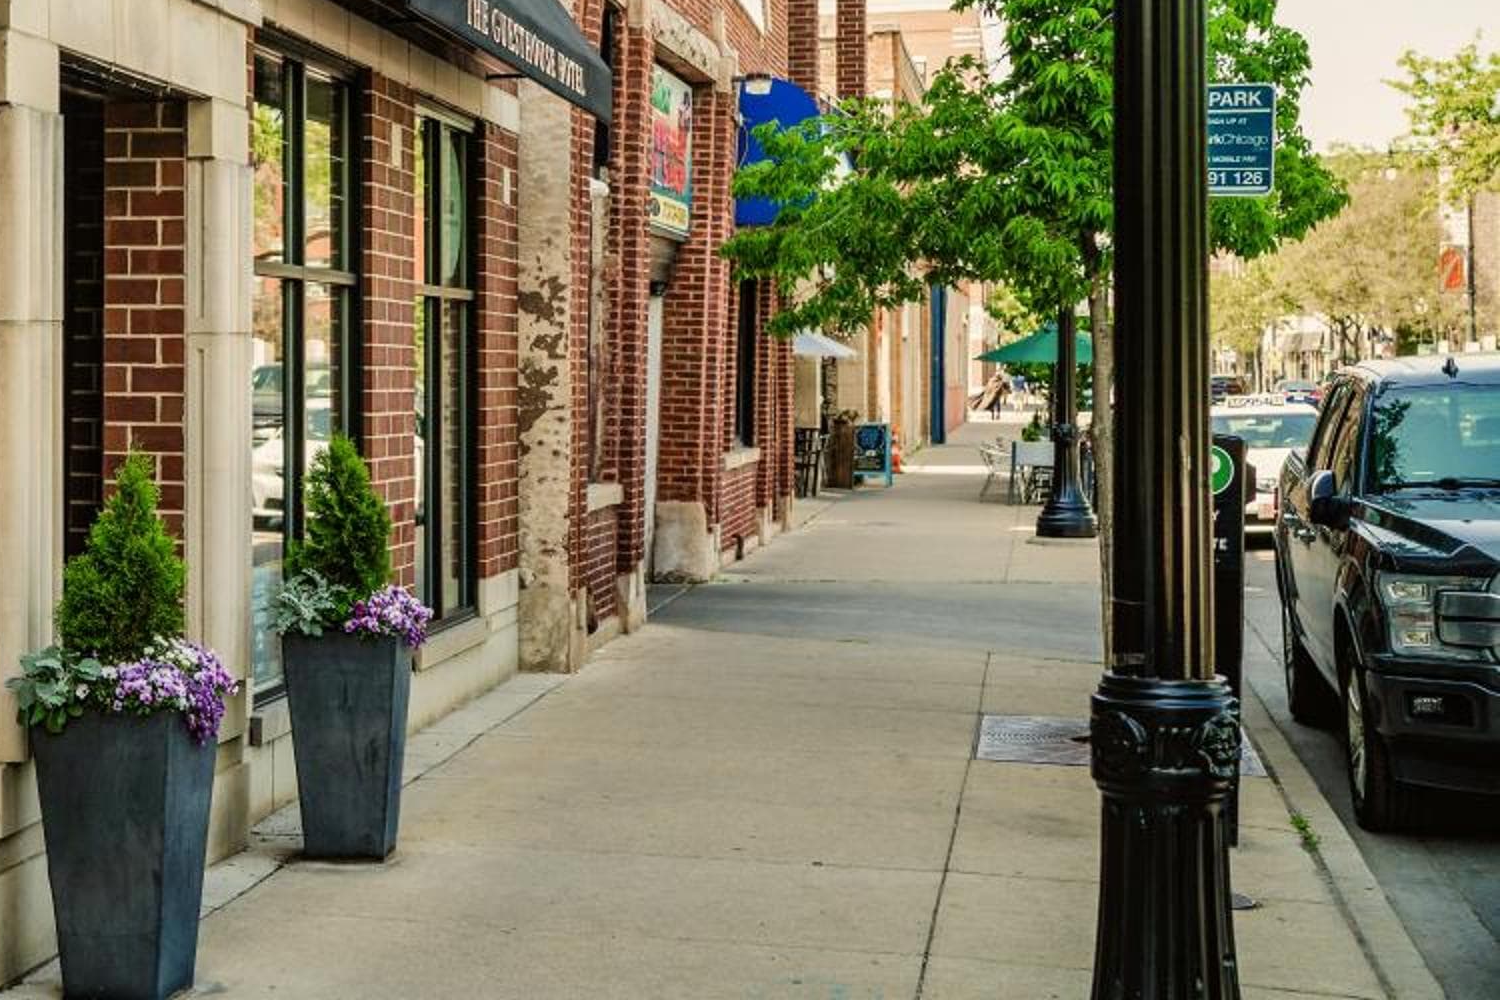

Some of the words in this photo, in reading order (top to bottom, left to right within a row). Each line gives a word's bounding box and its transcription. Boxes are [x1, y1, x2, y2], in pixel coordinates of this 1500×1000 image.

[491, 8, 557, 79] GUESTHOUSE
[557, 51, 586, 97] HOTEL
[1209, 91, 1263, 107] PARK
[1234, 172, 1263, 185] 126
